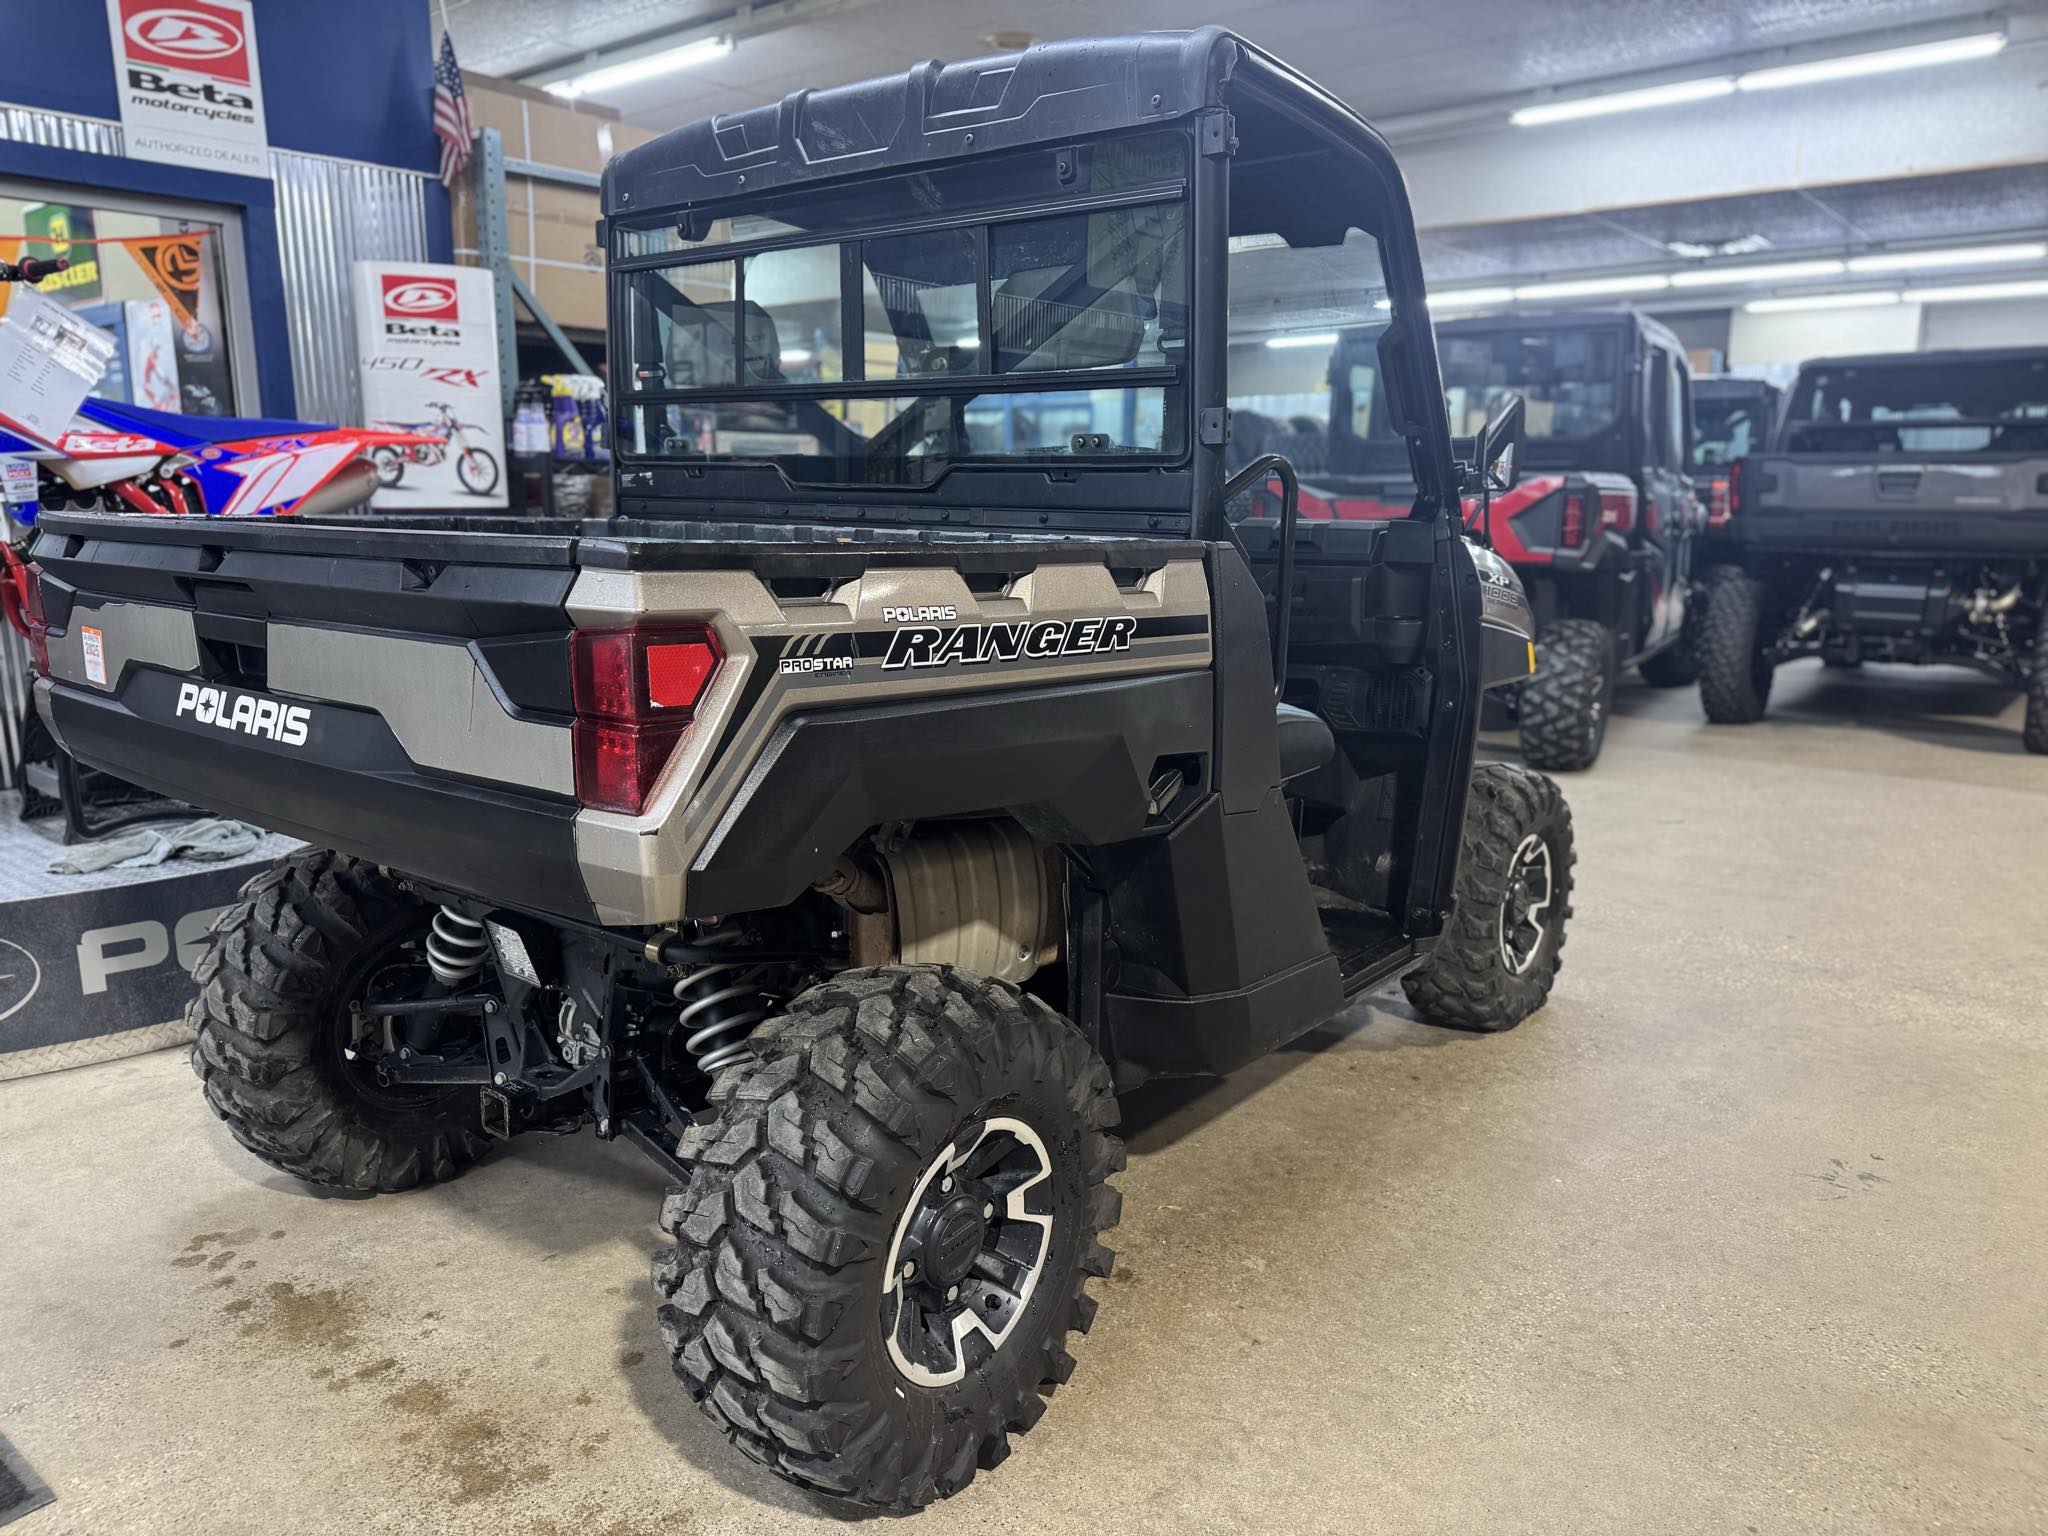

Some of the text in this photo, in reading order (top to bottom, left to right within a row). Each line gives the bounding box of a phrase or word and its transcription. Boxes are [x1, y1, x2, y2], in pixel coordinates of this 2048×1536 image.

[127, 68, 253, 110] Beta
[131, 95, 255, 125] motorcycles
[134, 137, 261, 165] AUTHORIZED DEALER
[385, 323, 461, 337] Beta
[1488, 574, 1511, 586] XP
[883, 604, 957, 623] POLARIS
[881, 615, 1138, 672] RANGER
[779, 656, 854, 675] PROSTAR
[175, 682, 312, 747] POLARIS
